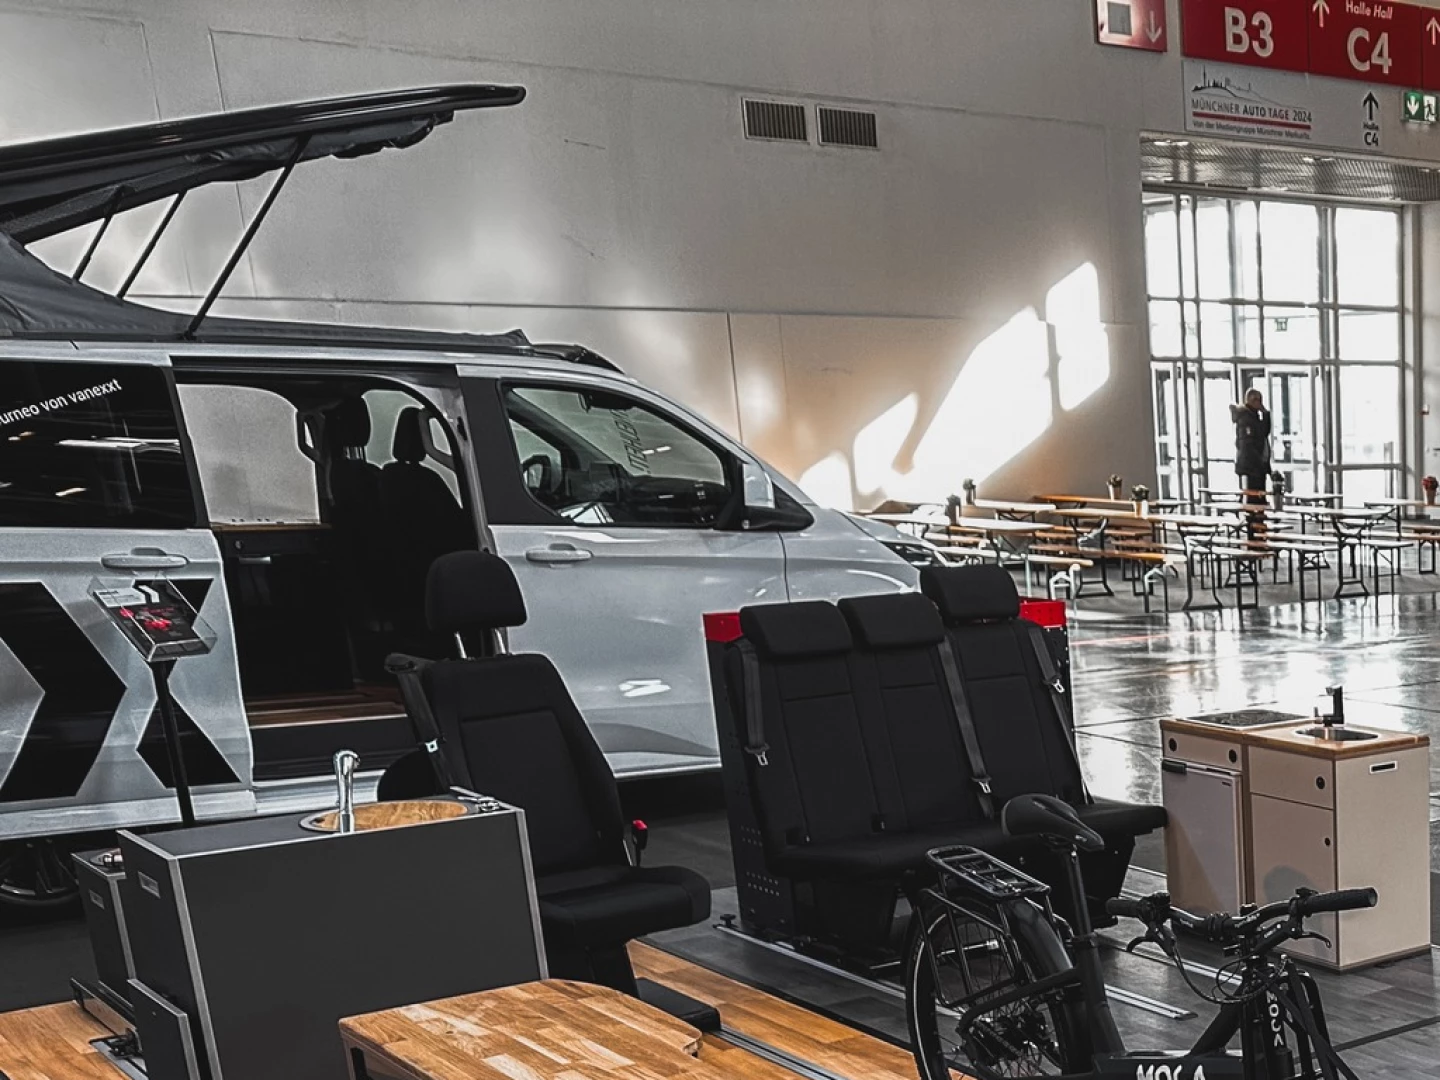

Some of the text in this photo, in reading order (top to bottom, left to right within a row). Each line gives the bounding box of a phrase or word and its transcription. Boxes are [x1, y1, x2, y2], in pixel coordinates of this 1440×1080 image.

[1345, 1, 1393, 20] Halle Hall
[1224, 6, 1274, 58] B3
[1346, 27, 1392, 74] C4
[1191, 97, 1312, 123] MÜNCHNER AUTO TAGE 2024
[1364, 131, 1379, 146] C4
[0, 378, 122, 426] urneo von vanexxt
